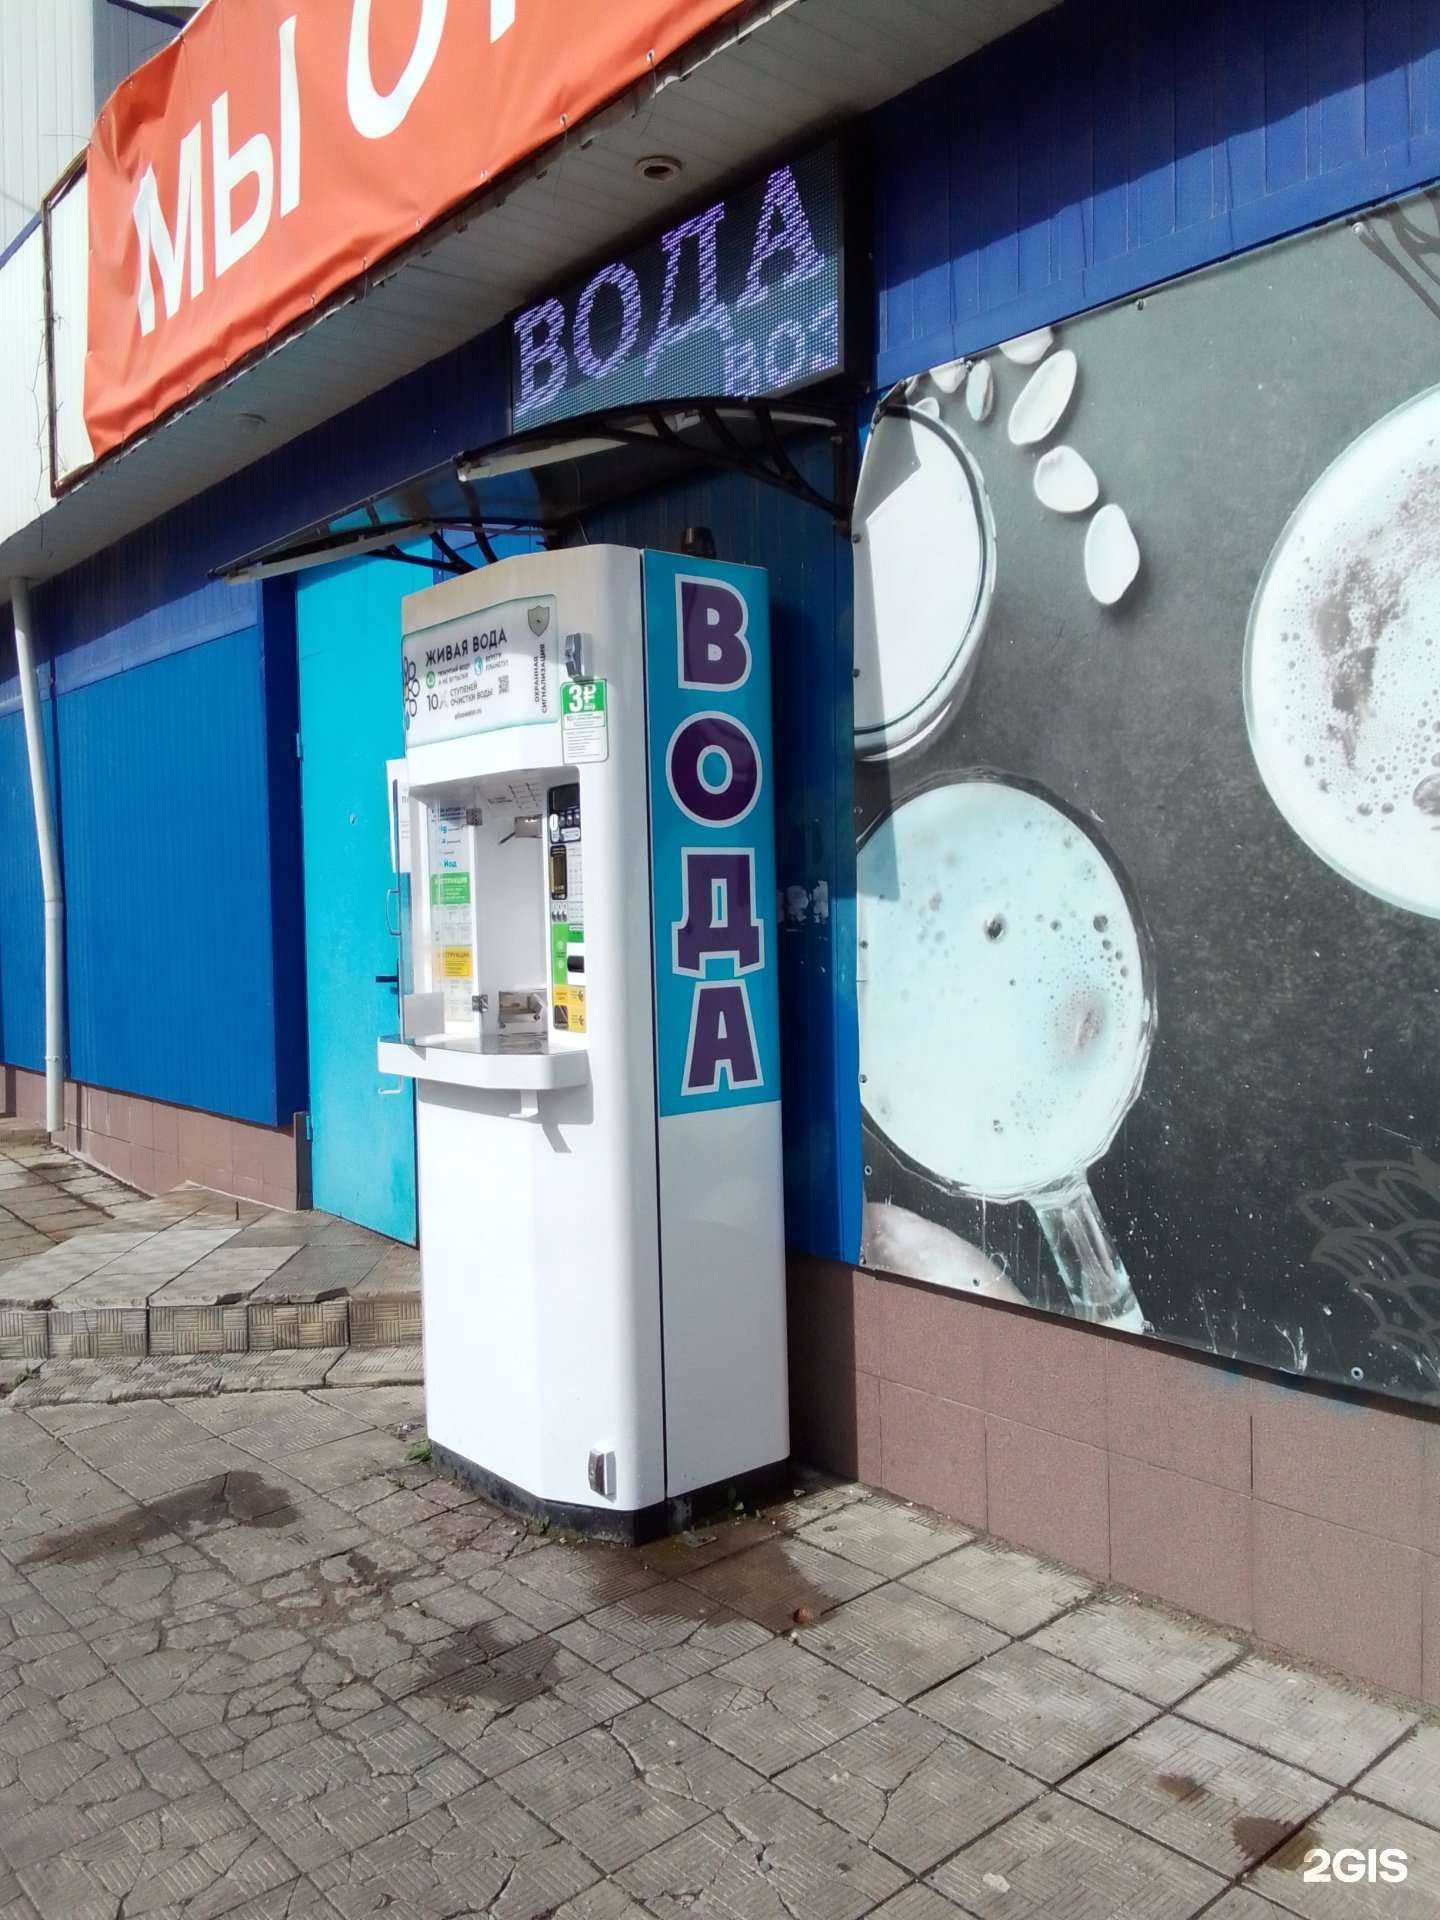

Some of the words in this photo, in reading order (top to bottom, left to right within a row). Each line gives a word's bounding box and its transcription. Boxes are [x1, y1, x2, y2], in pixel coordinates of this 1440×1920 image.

[133, 14, 300, 337] МЫ
[514, 165, 825, 418] ВОДА
[426, 639, 469, 667] ЖИВАЯ
[472, 627, 508, 652] ВОДА
[427, 693, 439, 712] 10
[539, 643, 548, 714] СИГНАЛИЗАЦИЯ
[665, 573, 766, 1097] ВОДА
